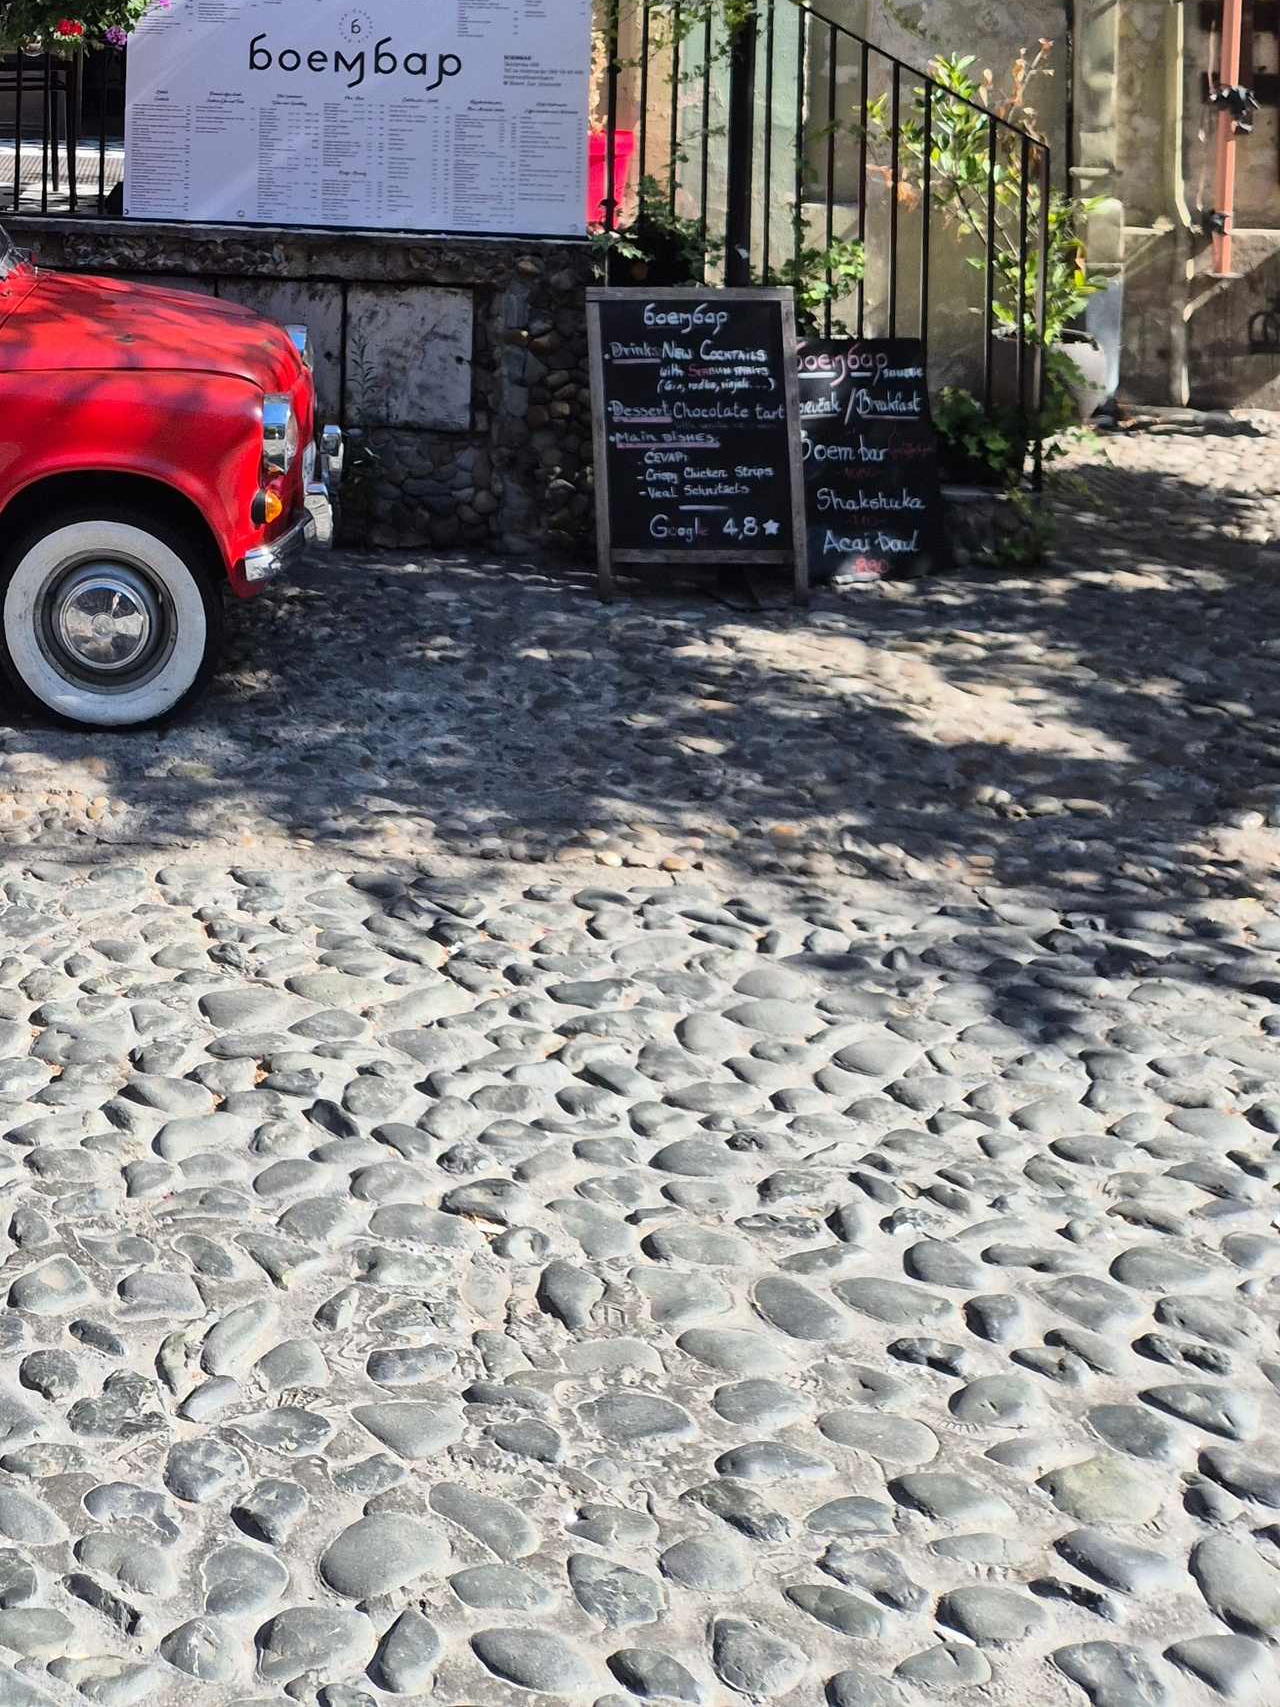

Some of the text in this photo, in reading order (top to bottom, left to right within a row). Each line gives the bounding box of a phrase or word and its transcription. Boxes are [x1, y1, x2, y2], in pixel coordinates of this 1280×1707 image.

[659, 363, 685, 378] with
[672, 400, 749, 419] Chocolate
[754, 402, 786, 420] tart
[645, 465, 774, 485] Crispy Chicken Strips
[816, 487, 926, 510] Shakshuka
[649, 513, 760, 543] Google 4,8
